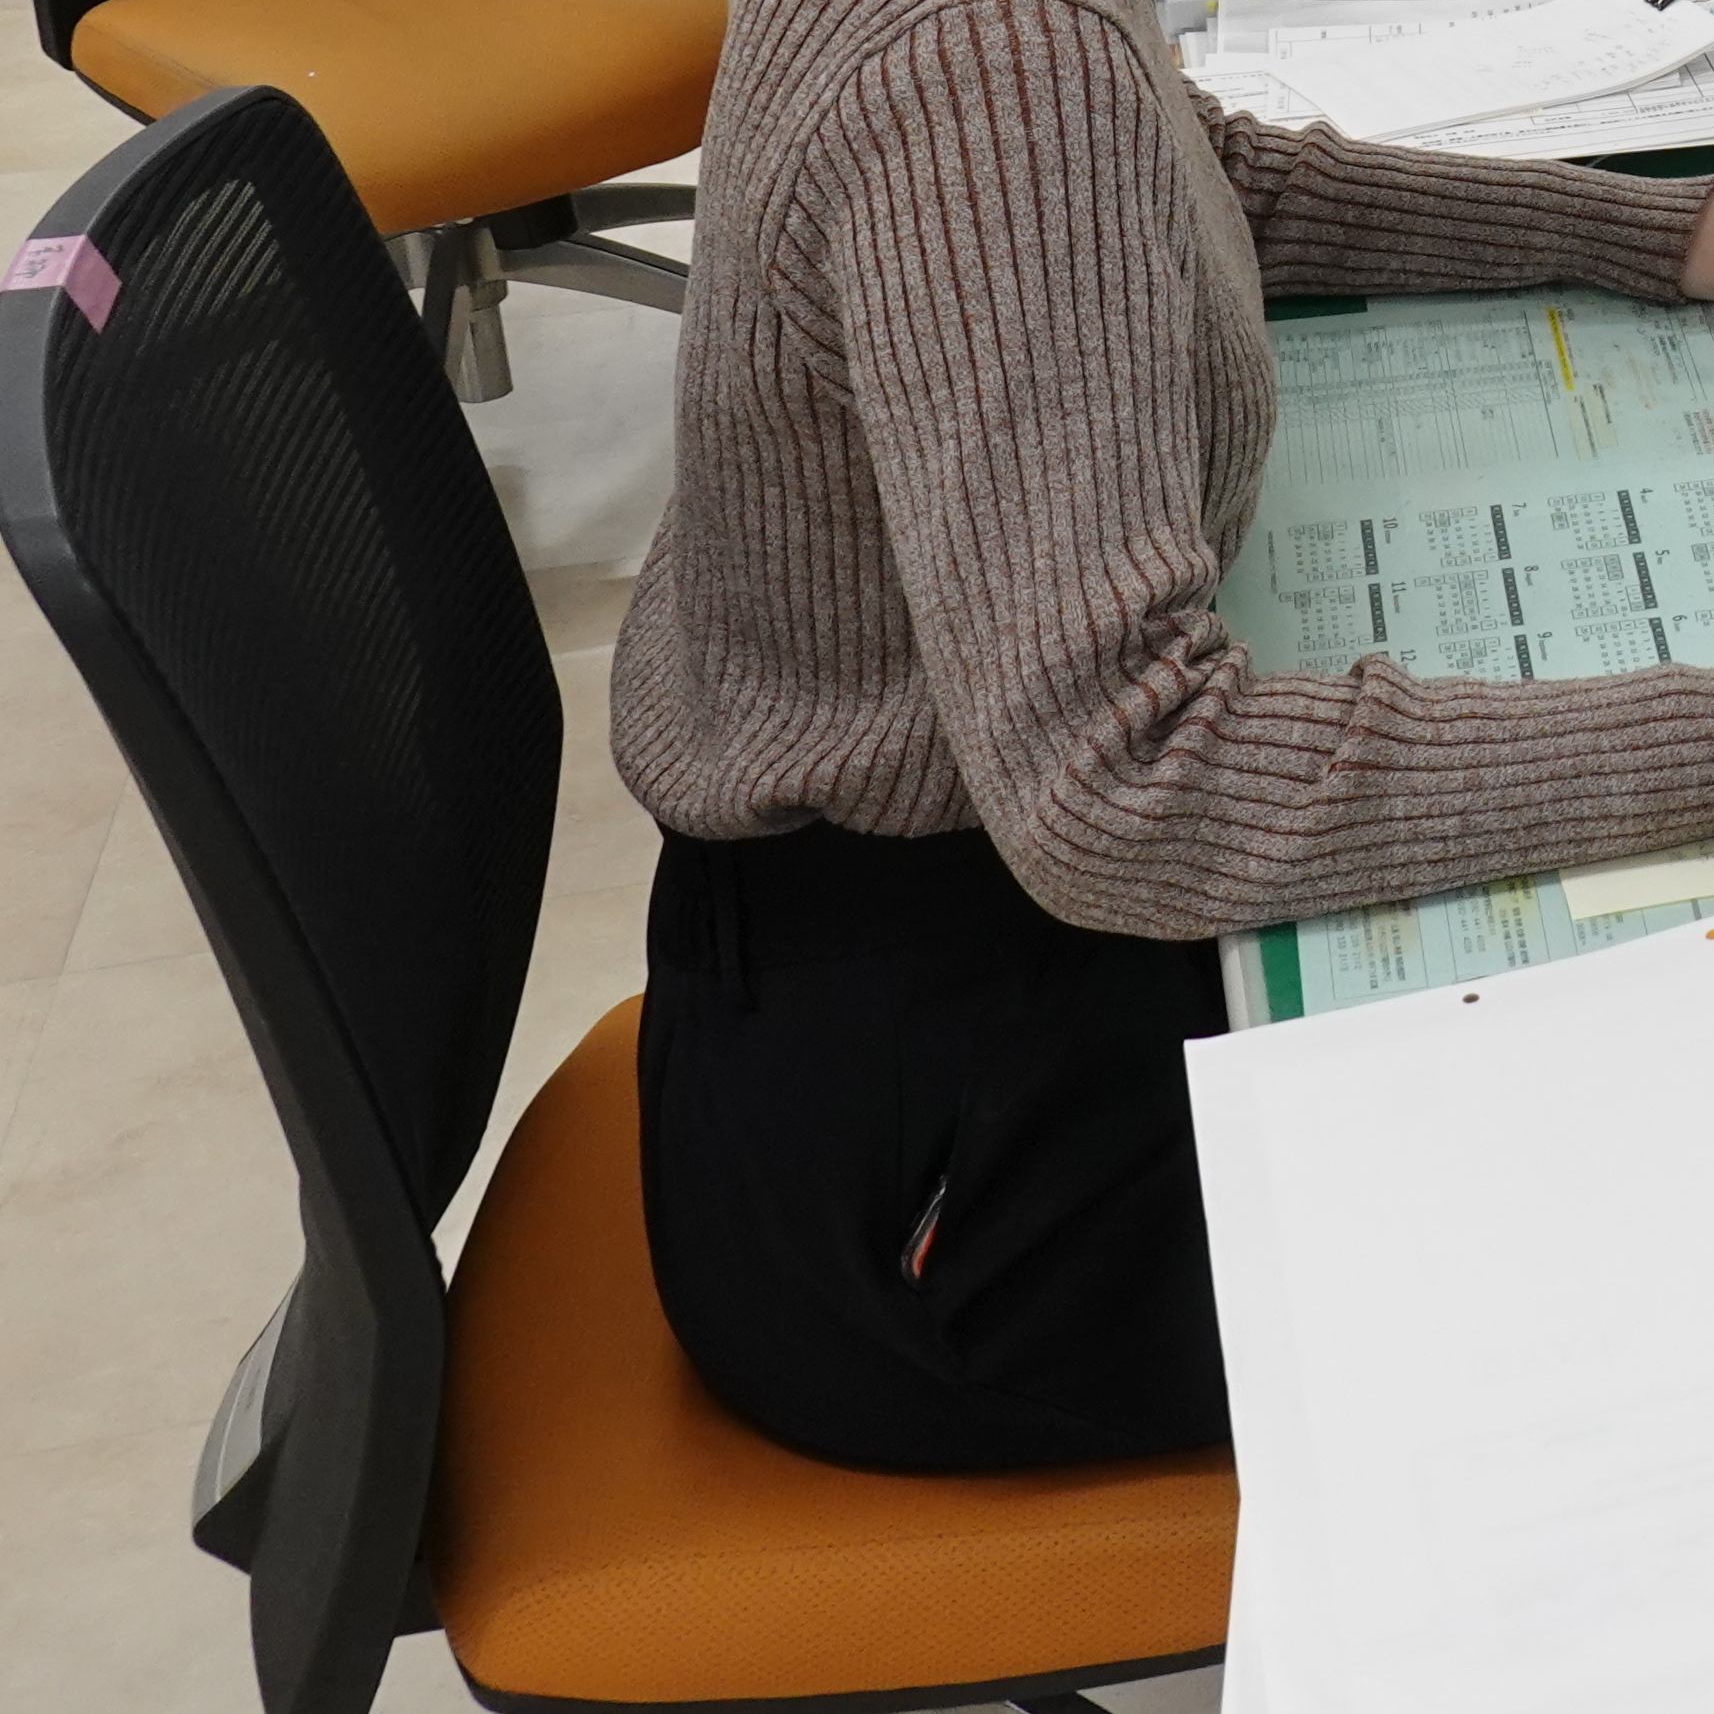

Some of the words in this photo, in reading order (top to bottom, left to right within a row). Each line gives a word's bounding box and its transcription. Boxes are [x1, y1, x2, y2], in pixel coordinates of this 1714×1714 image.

[1383, 517, 1397, 529] 10
[1655, 548, 1668, 556] 5
[1391, 581, 1405, 593] 11
[1673, 614, 1686, 622] 6
[1400, 649, 1415, 661] 12
